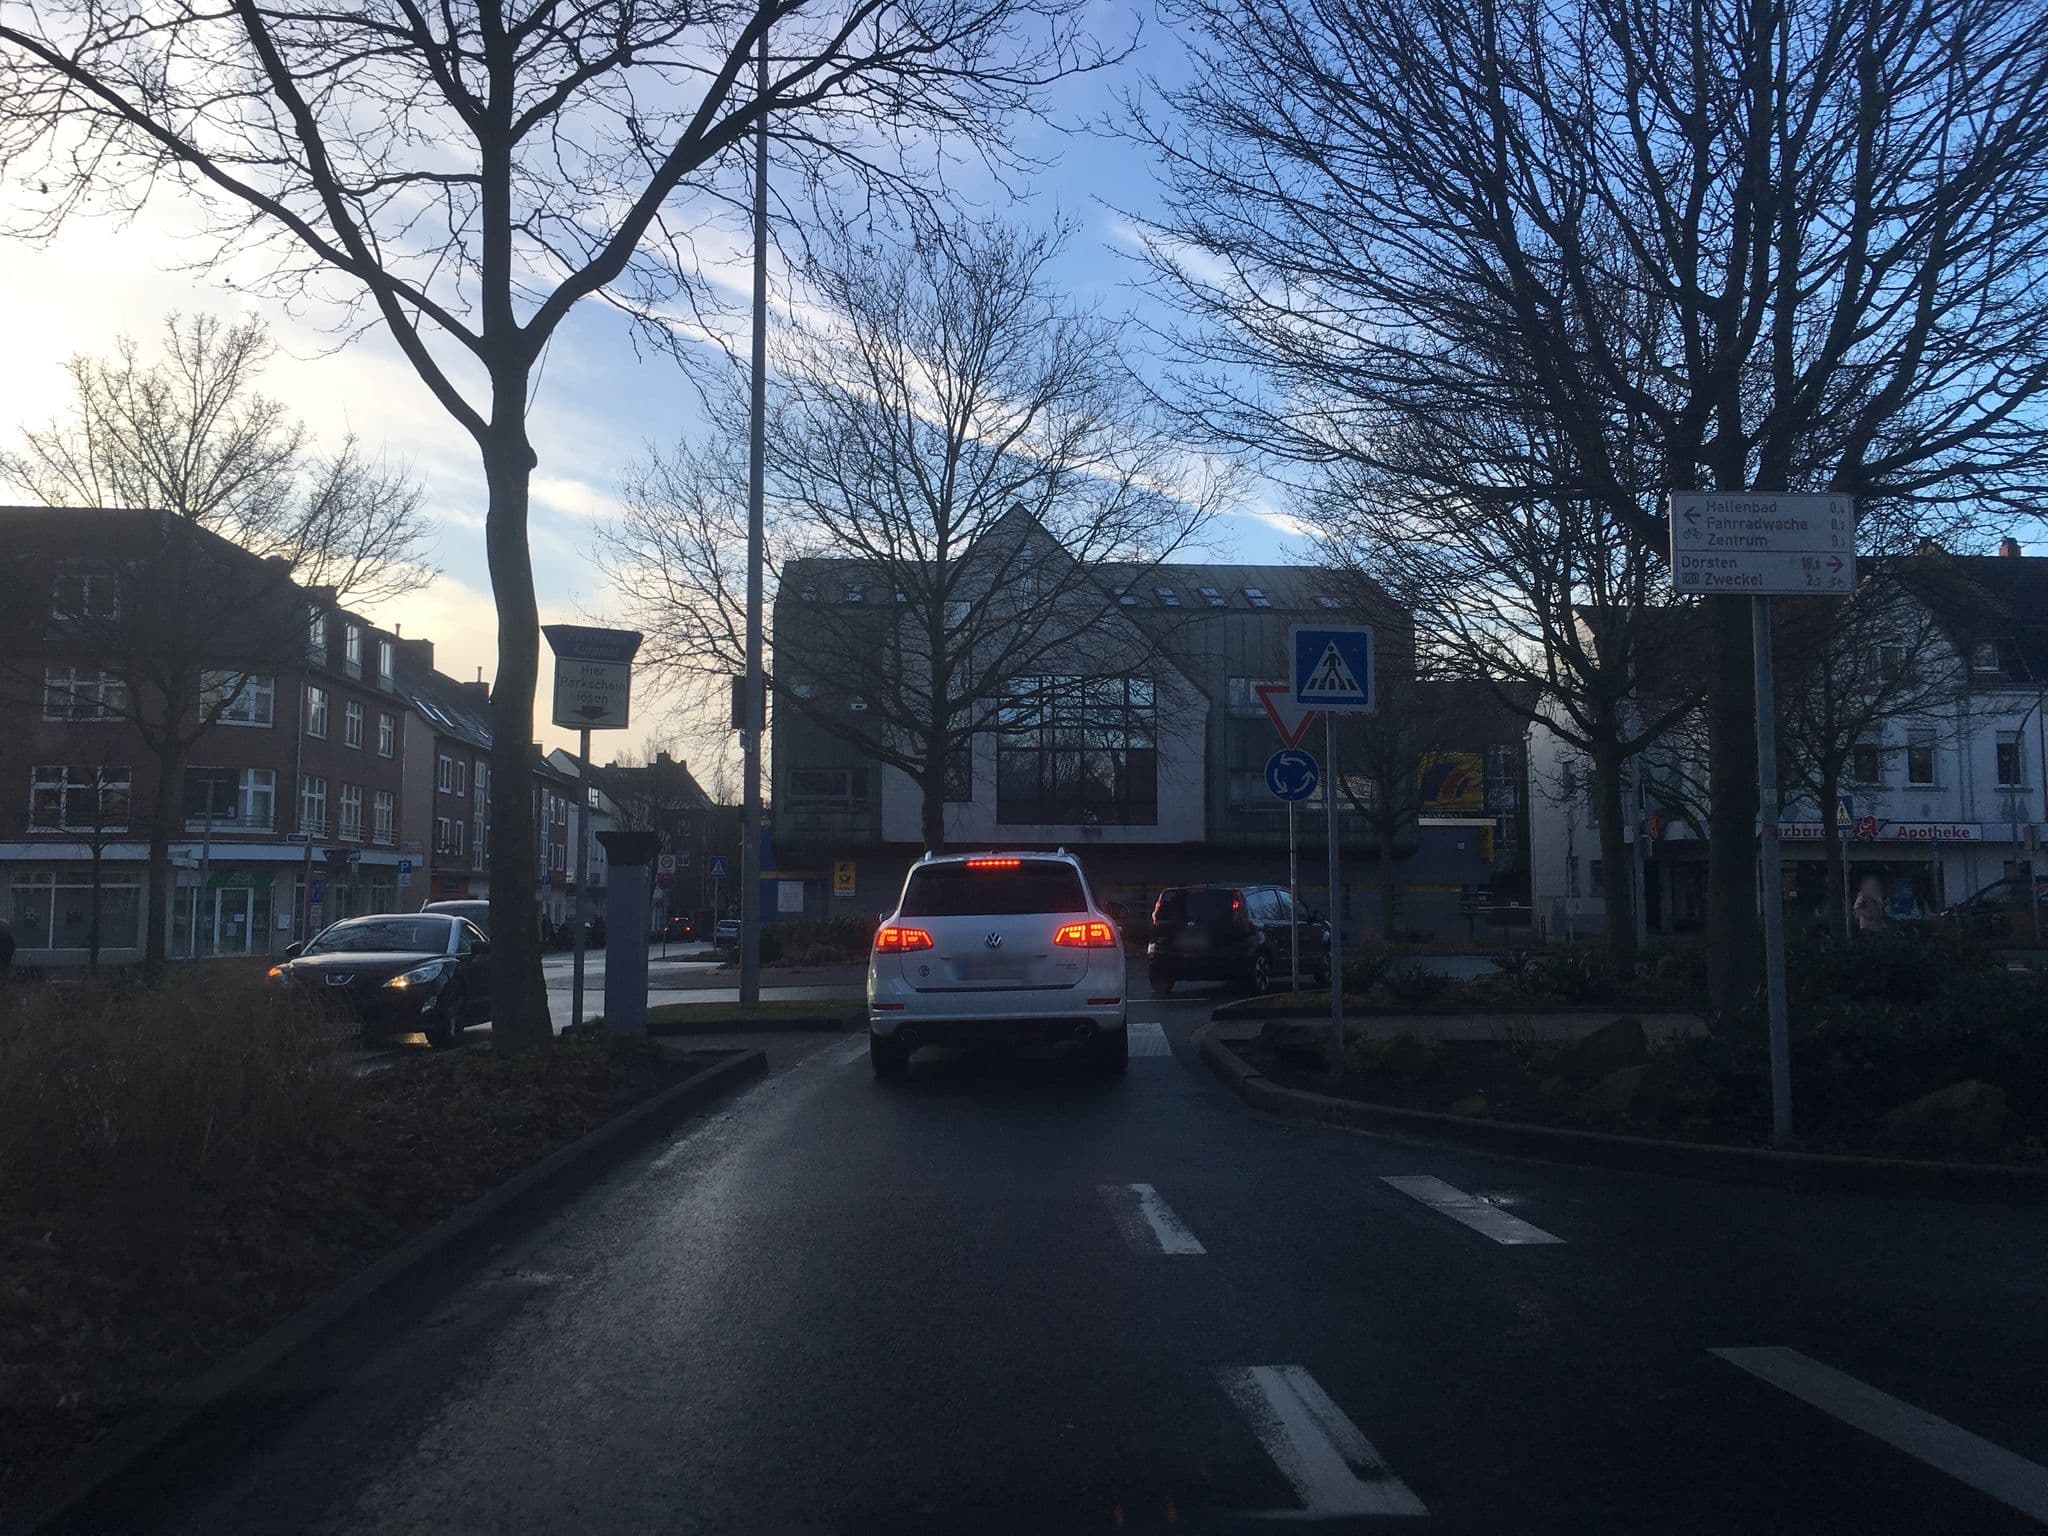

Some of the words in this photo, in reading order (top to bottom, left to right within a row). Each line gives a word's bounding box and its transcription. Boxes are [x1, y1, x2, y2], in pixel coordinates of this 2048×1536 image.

[1706, 501, 1777, 513] Hallenbad
[1706, 516, 1808, 530] Fahrradwache
[1707, 532, 1768, 546] Zentrum
[1681, 556, 1737, 568] Dorsten
[1704, 572, 1763, 586] Zweckel
[581, 663, 606, 675] Hier
[1898, 825, 1970, 839] Apotheke
